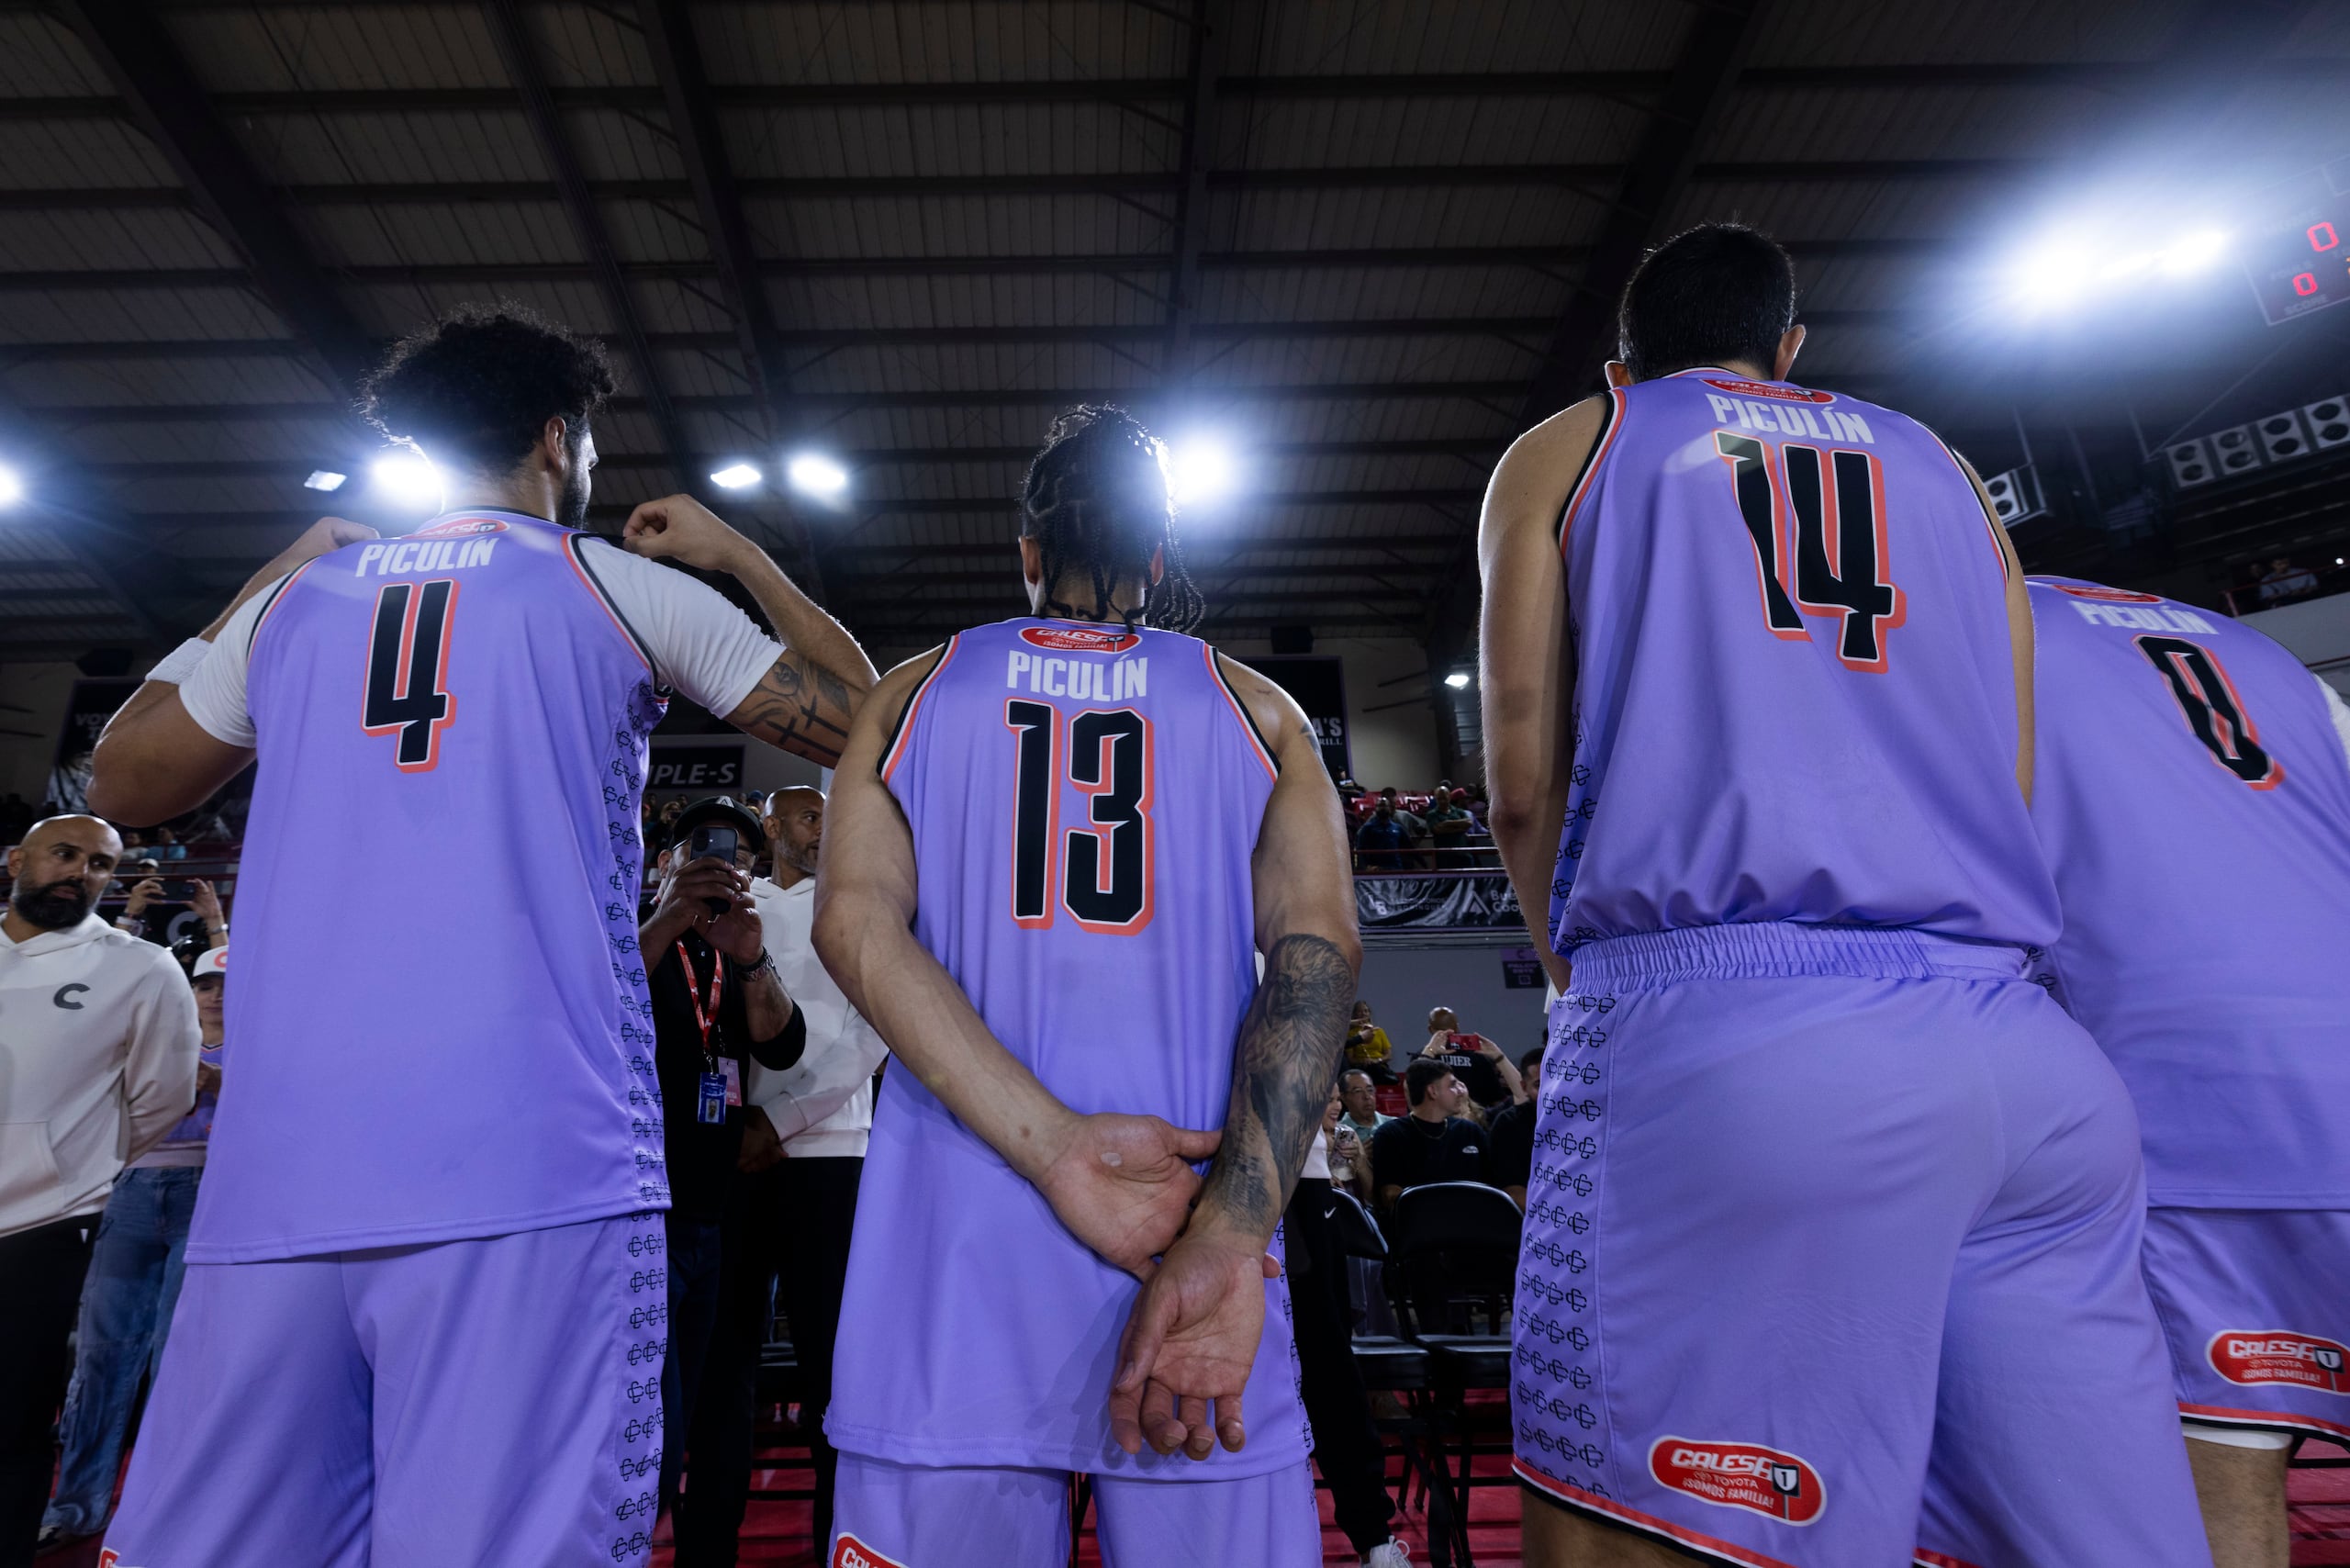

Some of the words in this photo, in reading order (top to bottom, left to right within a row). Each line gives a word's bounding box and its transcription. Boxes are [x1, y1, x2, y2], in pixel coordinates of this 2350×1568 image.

[2307, 221, 2339, 252] 0
[2292, 273, 2318, 296] 0
[1706, 393, 1874, 444] PICULÍN
[355, 535, 499, 577] PICULÍN
[1713, 429, 1907, 674] 14
[360, 577, 461, 774] 4
[1007, 650, 1147, 701] PICULÍN
[2131, 633, 2286, 791] 0
[1004, 698, 1154, 936] 13
[53, 982, 91, 1010] C
[2228, 1339, 2317, 1361] CALESA
[2262, 1359, 2303, 1368] TOYOTA
[1671, 1449, 1773, 1482] CALESA
[1713, 1473, 1759, 1489] TOYOTA
[1684, 1478, 1725, 1498] ¡SOMOS
[1726, 1487, 1774, 1508] FAMILIA!
